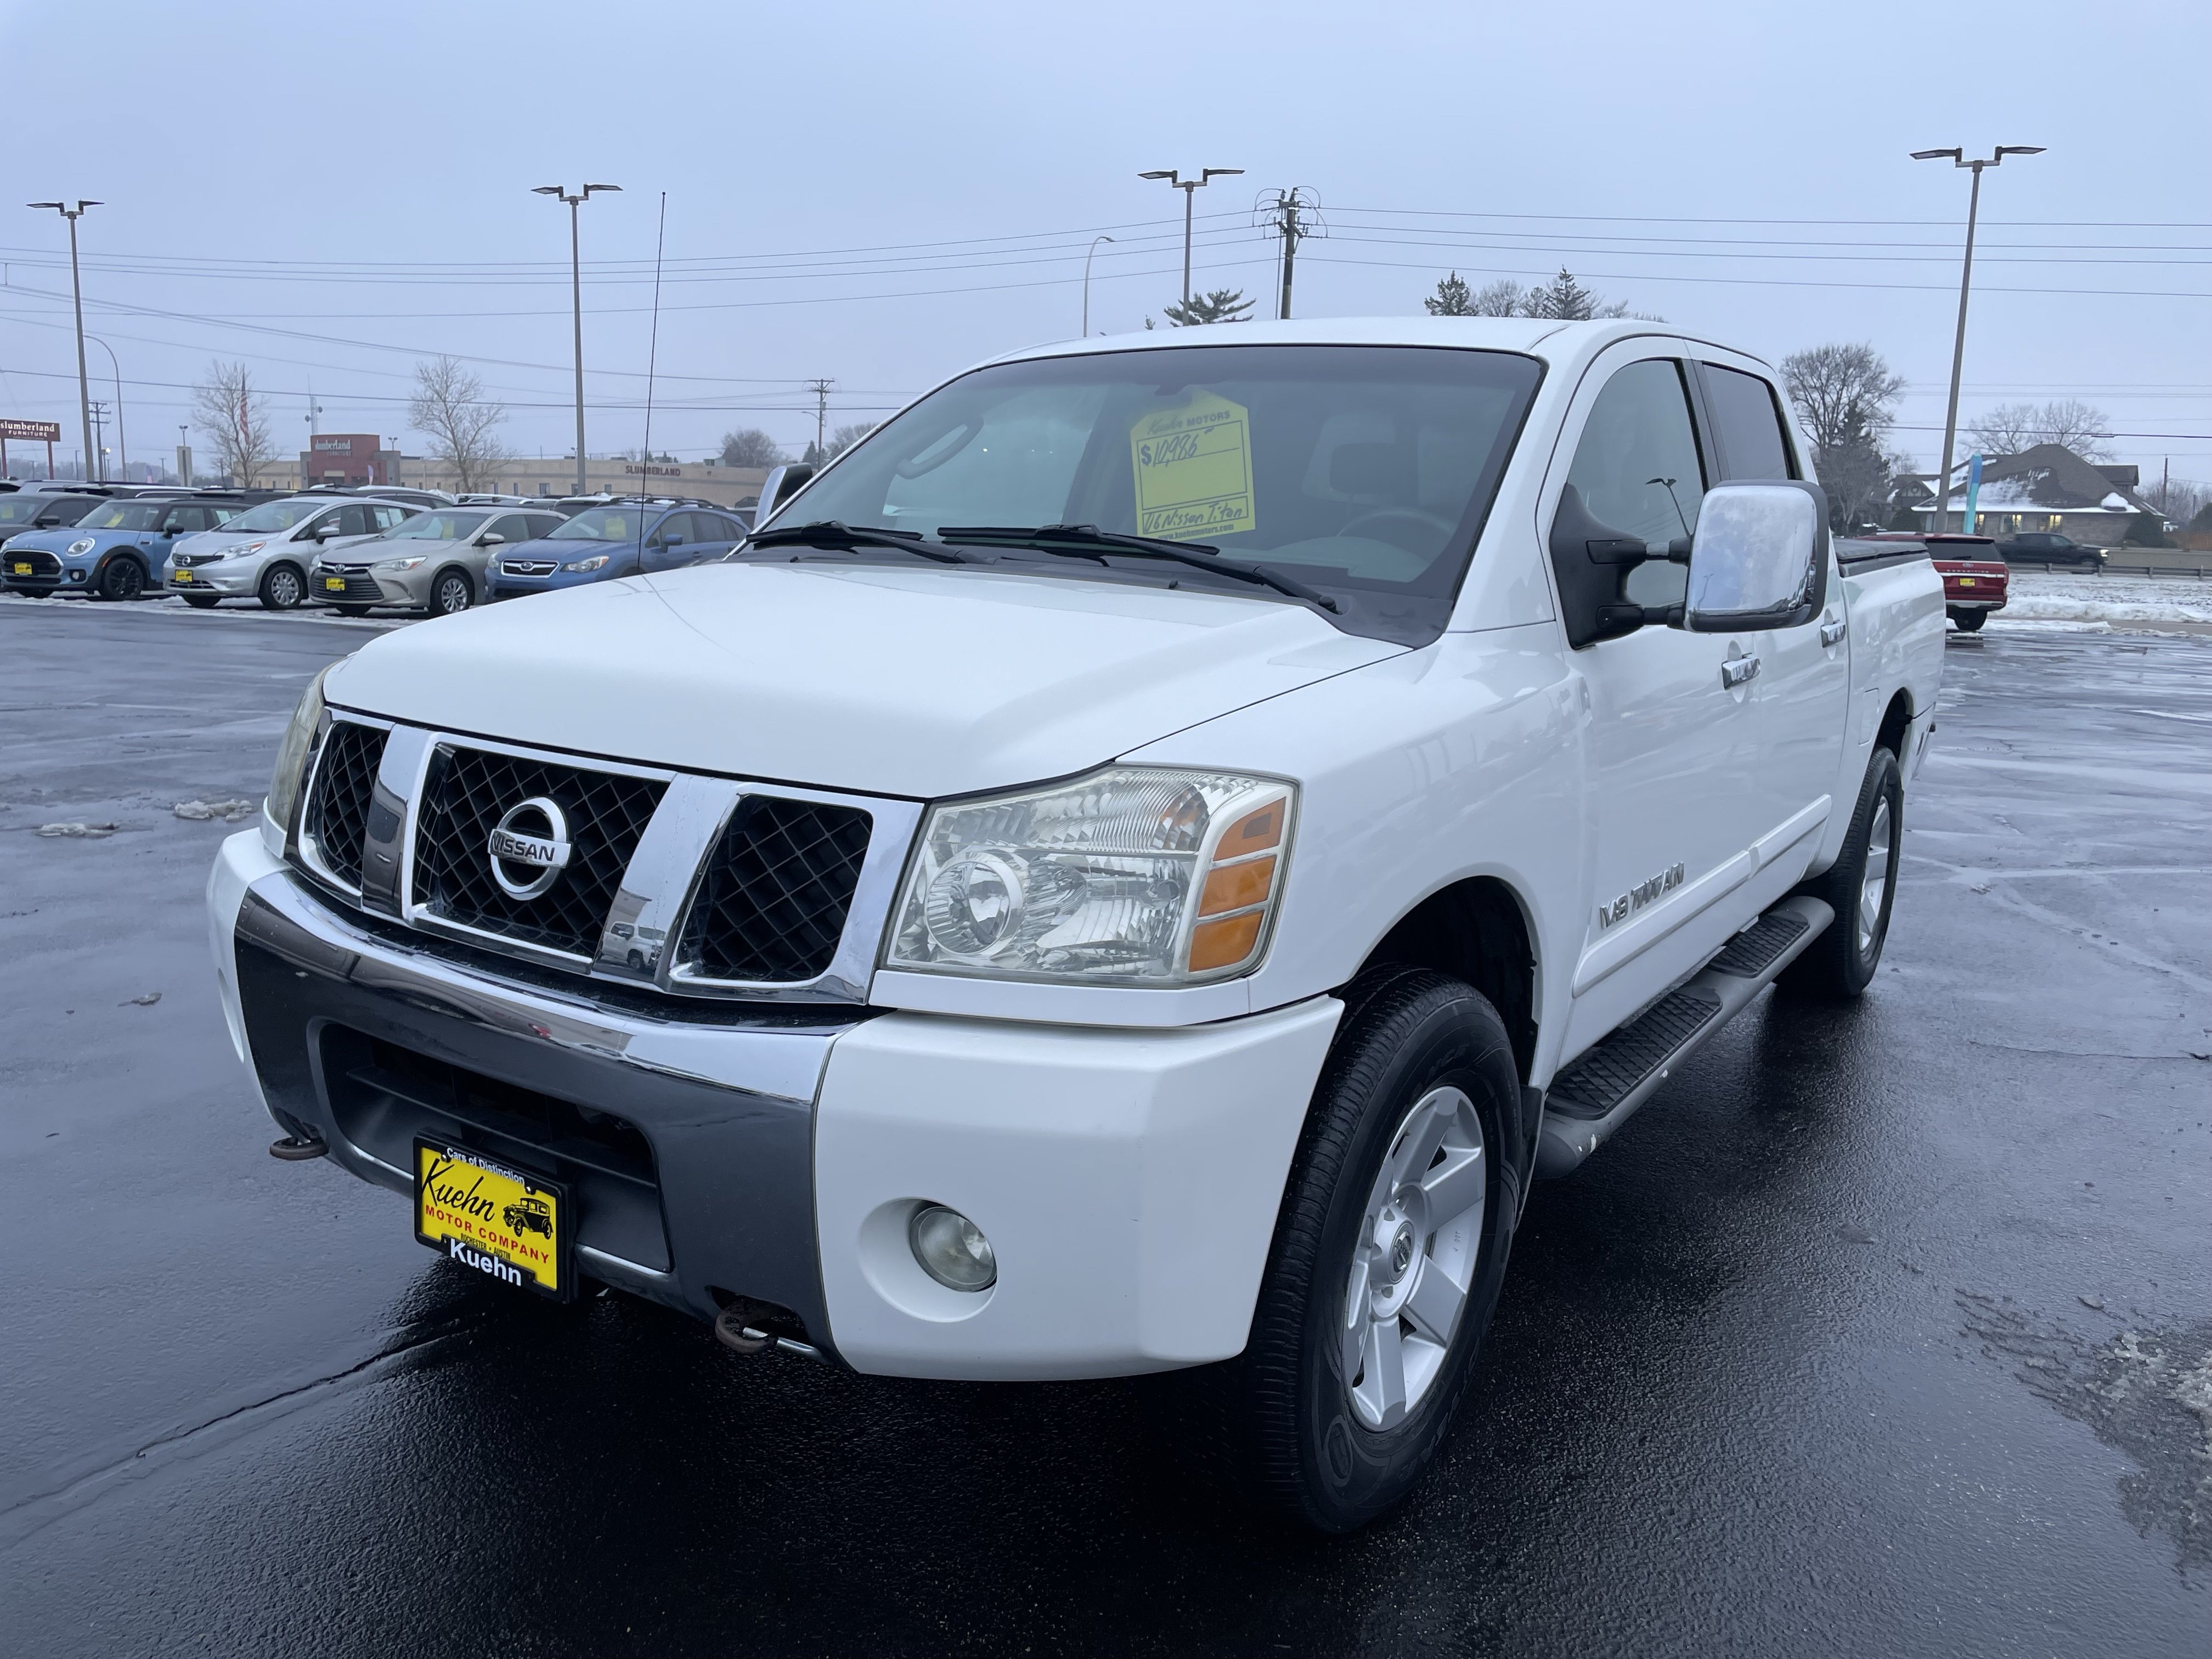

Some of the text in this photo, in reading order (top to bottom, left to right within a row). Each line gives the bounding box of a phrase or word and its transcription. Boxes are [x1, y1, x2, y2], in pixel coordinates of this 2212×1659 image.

[1, 420, 55, 432] slumberland
[1187, 410, 1230, 426] MOTORS
[625, 465, 681, 477] SLUMBERLAND
[492, 832, 556, 862] NISSAN
[1600, 861, 1684, 930] V8 TITAN
[447, 1147, 525, 1185] Cars of Distinction
[421, 1158, 495, 1222] Kuehn
[425, 1204, 549, 1264] MOTOR COMPANY
[460, 1233, 511, 1261] ROCHESTER AUSTIN
[450, 1238, 521, 1286] Kuehn
